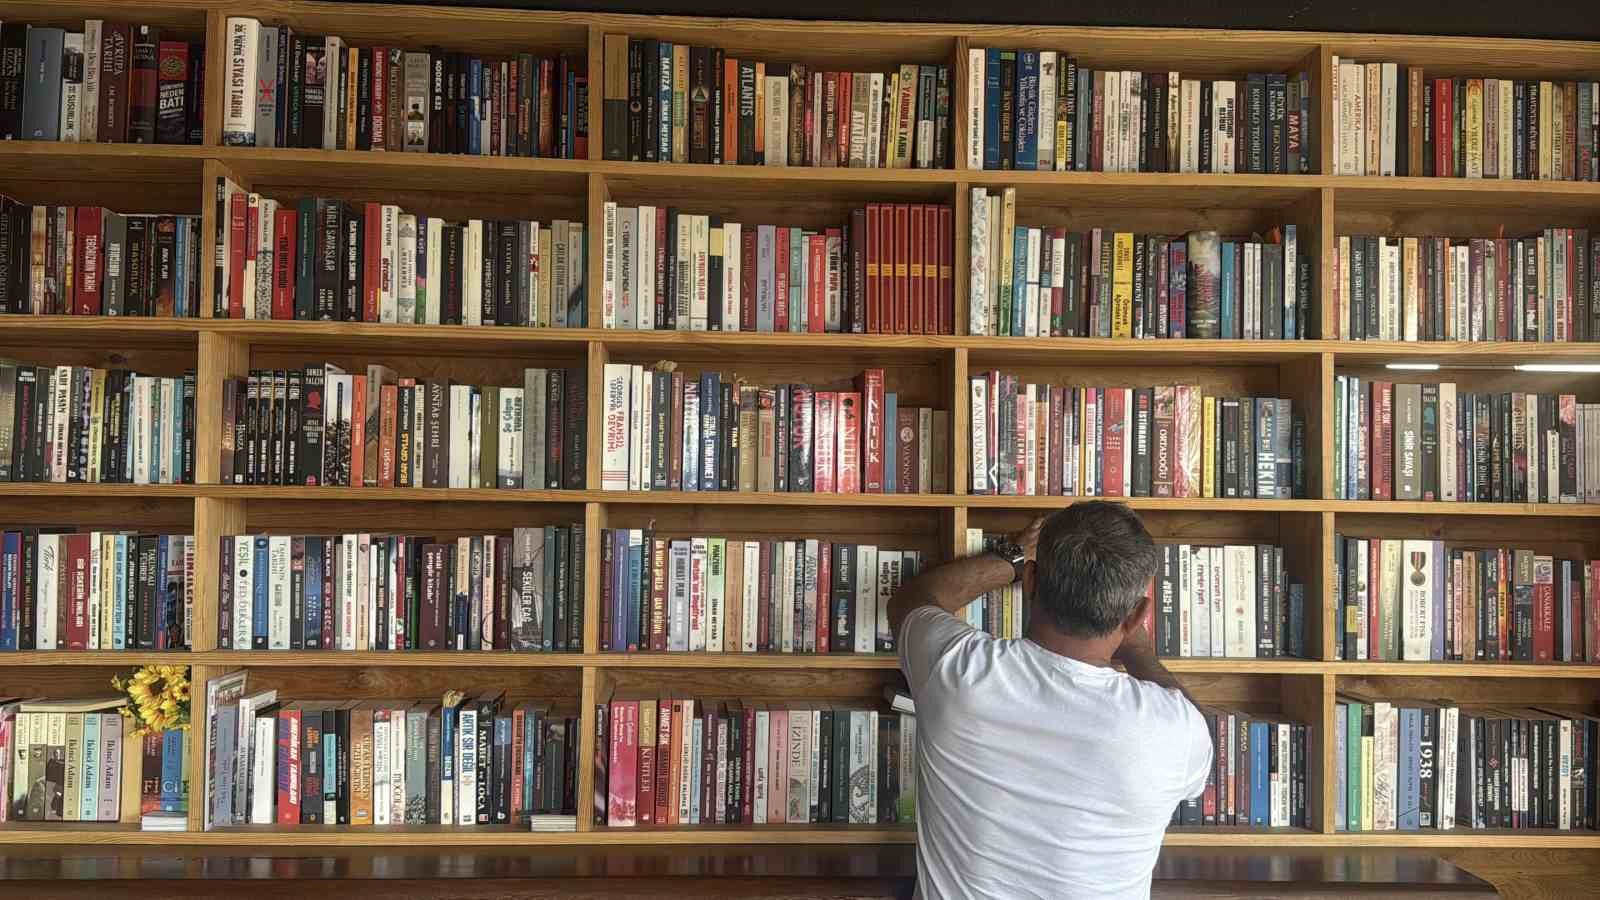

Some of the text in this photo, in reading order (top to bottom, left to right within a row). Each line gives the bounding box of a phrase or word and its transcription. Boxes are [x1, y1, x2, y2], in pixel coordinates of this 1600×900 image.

[232, 58, 244, 87] SİYASİ
[1026, 75, 1037, 99] Büyük
[160, 97, 184, 110] BATI
[1252, 88, 1261, 124] KOMPLO
[850, 111, 866, 160] ATATÜRK
[1289, 114, 1299, 149] MAYA
[1158, 428, 1169, 479] ORTADOĞU
[400, 465, 409, 484] BEAR
[521, 570, 535, 606] SEKÜLER
[462, 713, 475, 736] ARTIK
[478, 729, 487, 769] MABET
[1420, 740, 1433, 779] 1938
[66, 763, 76, 788] Adam
[85, 763, 95, 789] Adam
[104, 764, 114, 789] Adam
[477, 781, 486, 810] LOCA
